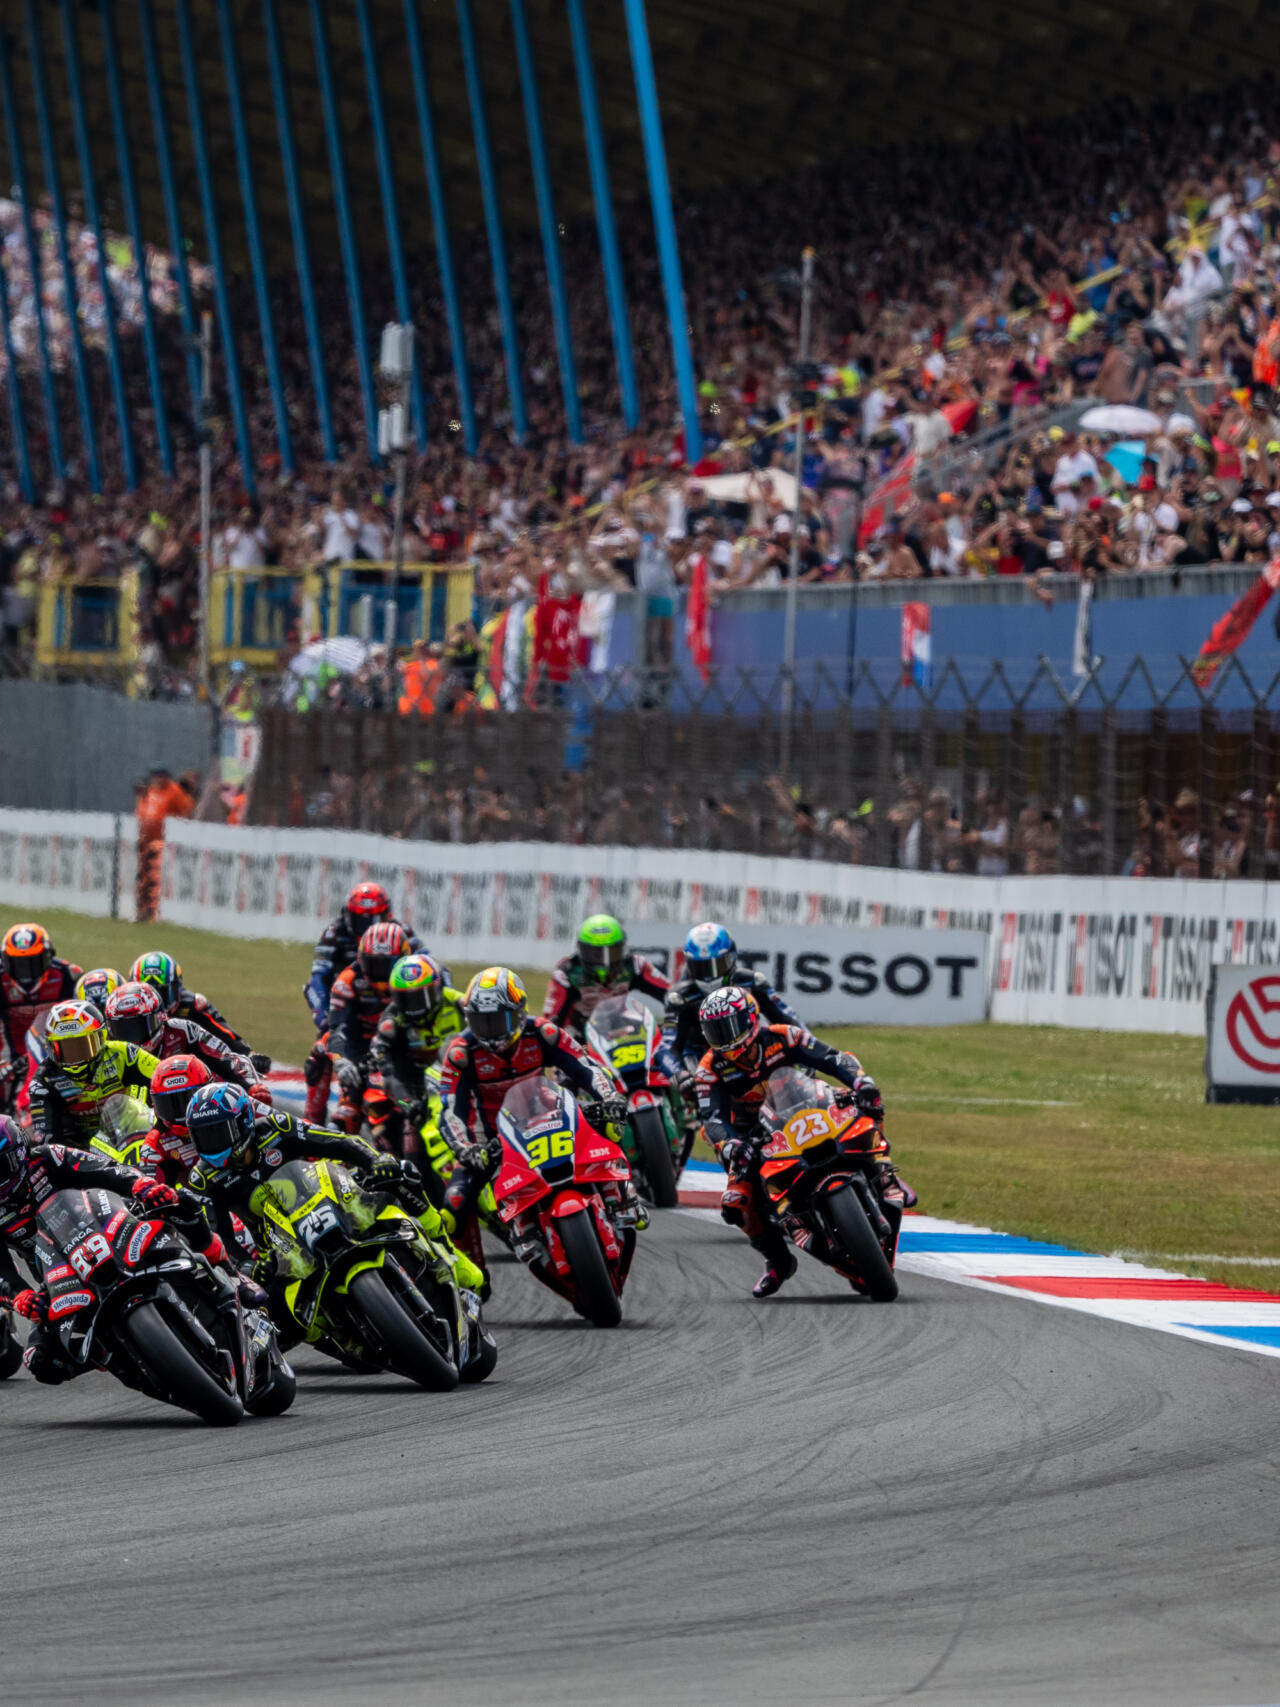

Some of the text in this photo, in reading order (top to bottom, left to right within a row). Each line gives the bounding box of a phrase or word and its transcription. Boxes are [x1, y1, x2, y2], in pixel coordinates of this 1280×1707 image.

[739, 950, 978, 997] TISSOT
[59, 1022, 77, 1032] SHOEI
[163, 1077, 185, 1087] SHOEI
[192, 1108, 219, 1119] SHARK
[790, 1112, 829, 1146] 23
[526, 1129, 574, 1169] 36
[588, 1147, 610, 1158] IBM
[502, 1174, 522, 1190] IBM
[298, 1205, 337, 1250] 25
[63, 1226, 94, 1254] TARGA
[130, 1224, 150, 1260] sterilgarda
[155, 1233, 171, 1249] sky
[69, 1233, 113, 1282] 89
[53, 1294, 89, 1310] sterilgarda
